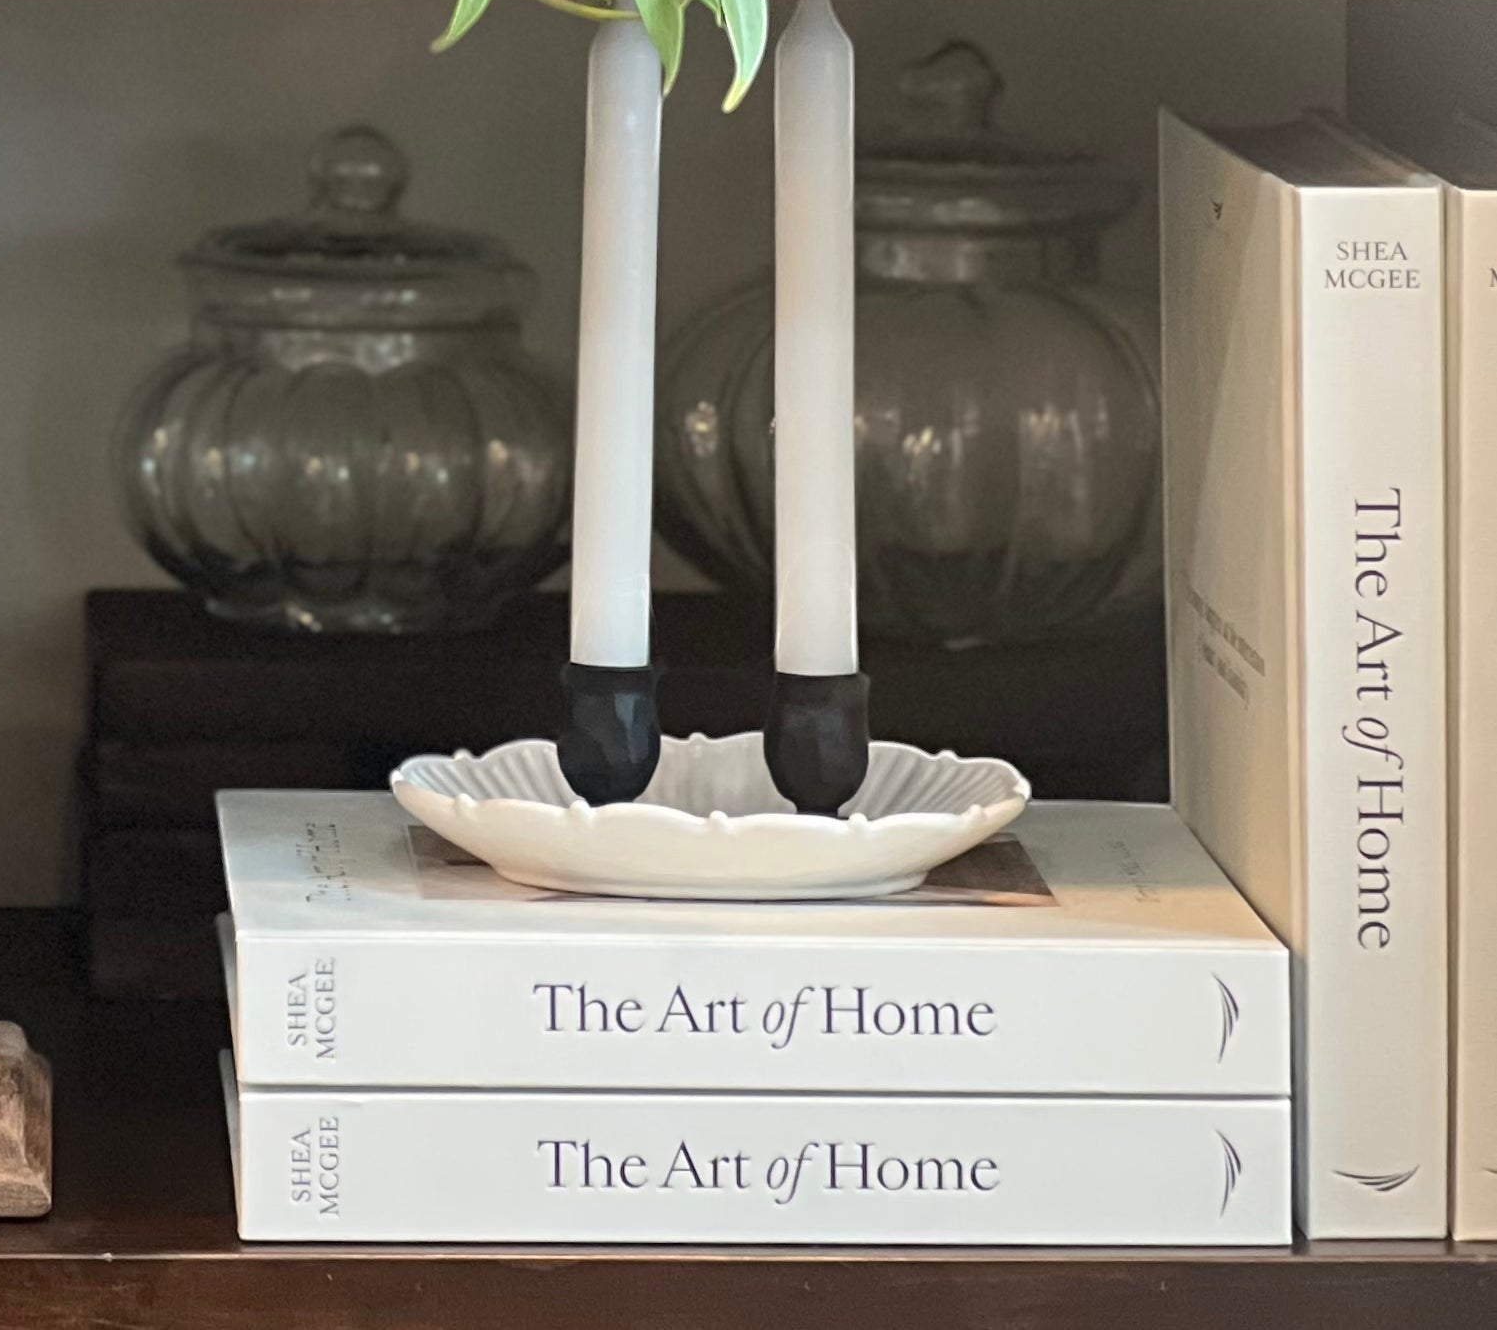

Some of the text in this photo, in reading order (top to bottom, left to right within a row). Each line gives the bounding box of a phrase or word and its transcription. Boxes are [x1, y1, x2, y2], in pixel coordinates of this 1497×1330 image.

[1324, 268, 1422, 290] MCGEE
[1336, 240, 1408, 262] SHEA
[1341, 486, 1405, 951] The Art of Home
[287, 971, 308, 1047] SHEA
[314, 956, 337, 1059] MCGEE
[532, 980, 996, 1050] The Art of Home
[291, 1128, 312, 1203] SHEA
[318, 1116, 340, 1215] MCGEE
[537, 1138, 1001, 1206] The Art of Home
